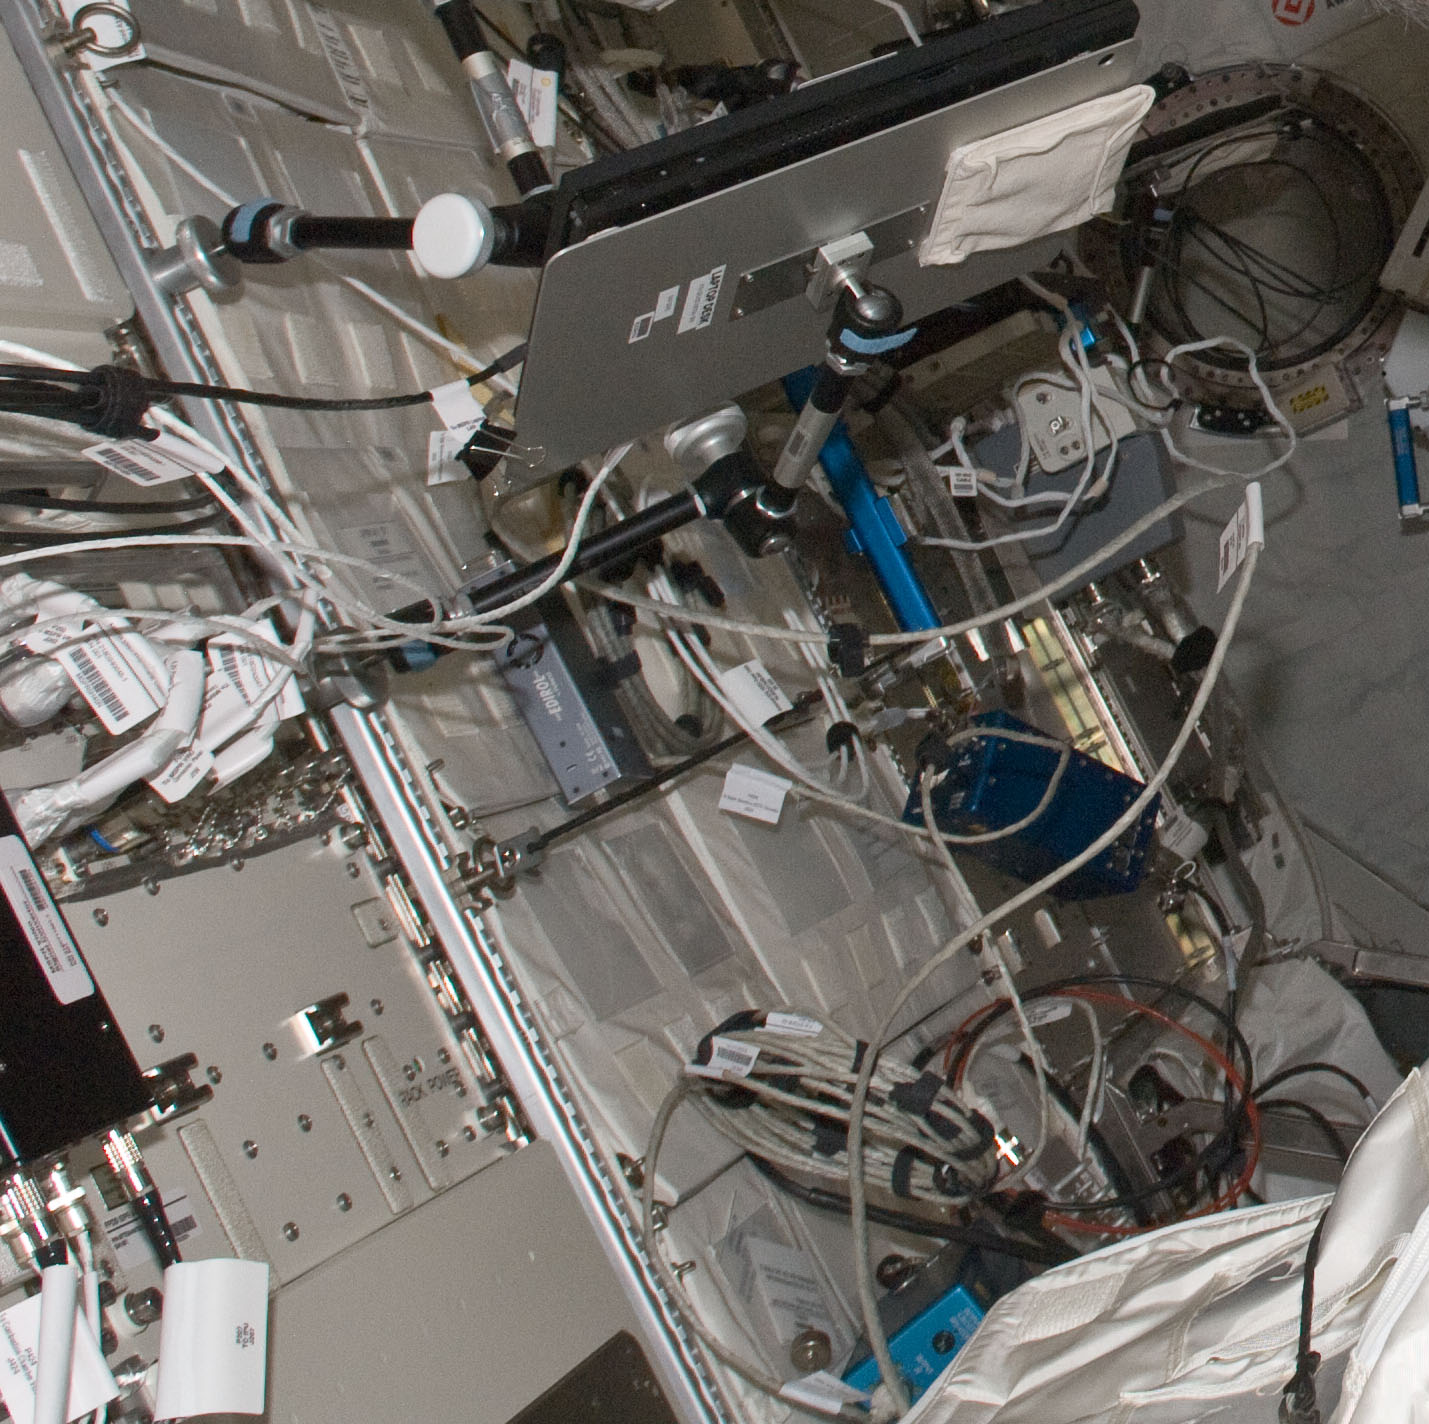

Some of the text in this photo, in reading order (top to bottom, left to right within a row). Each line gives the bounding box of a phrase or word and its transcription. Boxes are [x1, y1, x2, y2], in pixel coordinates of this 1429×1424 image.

[698, 269, 723, 325] LAPTOP DESK
[534, 674, 561, 716] EDIROL
[398, 1067, 462, 1104] RACK POWER
